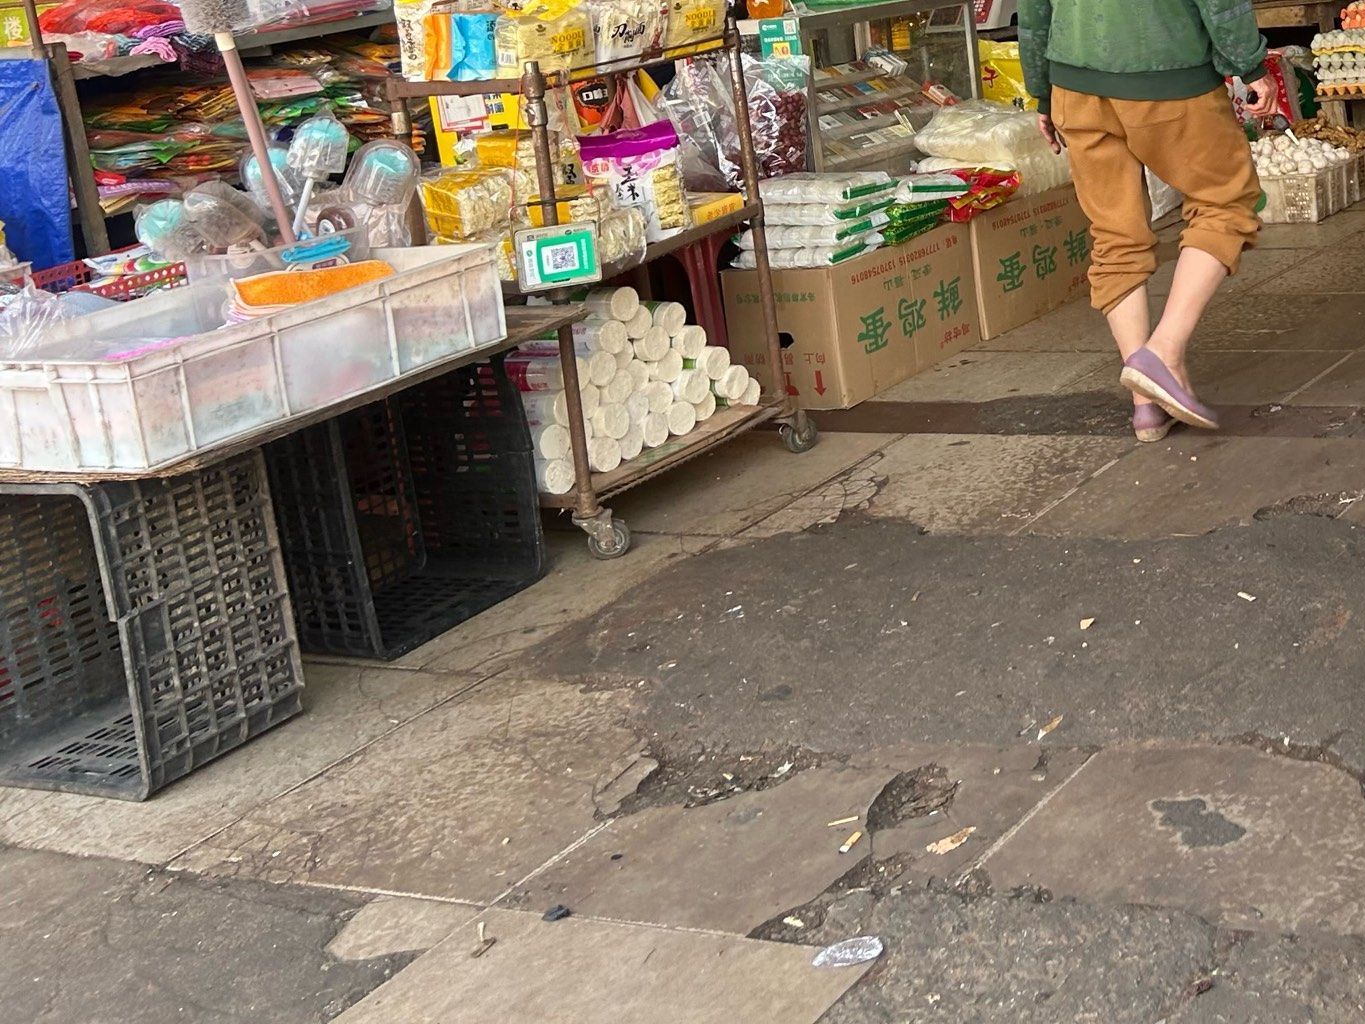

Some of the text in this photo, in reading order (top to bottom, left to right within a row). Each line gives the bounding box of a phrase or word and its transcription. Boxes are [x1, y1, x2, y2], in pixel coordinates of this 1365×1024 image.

[996, 227, 1089, 293] 鲜鸡蛋
[857, 276, 963, 355] 鲜鸡蛋
[803, 352, 825, 364] 向上
